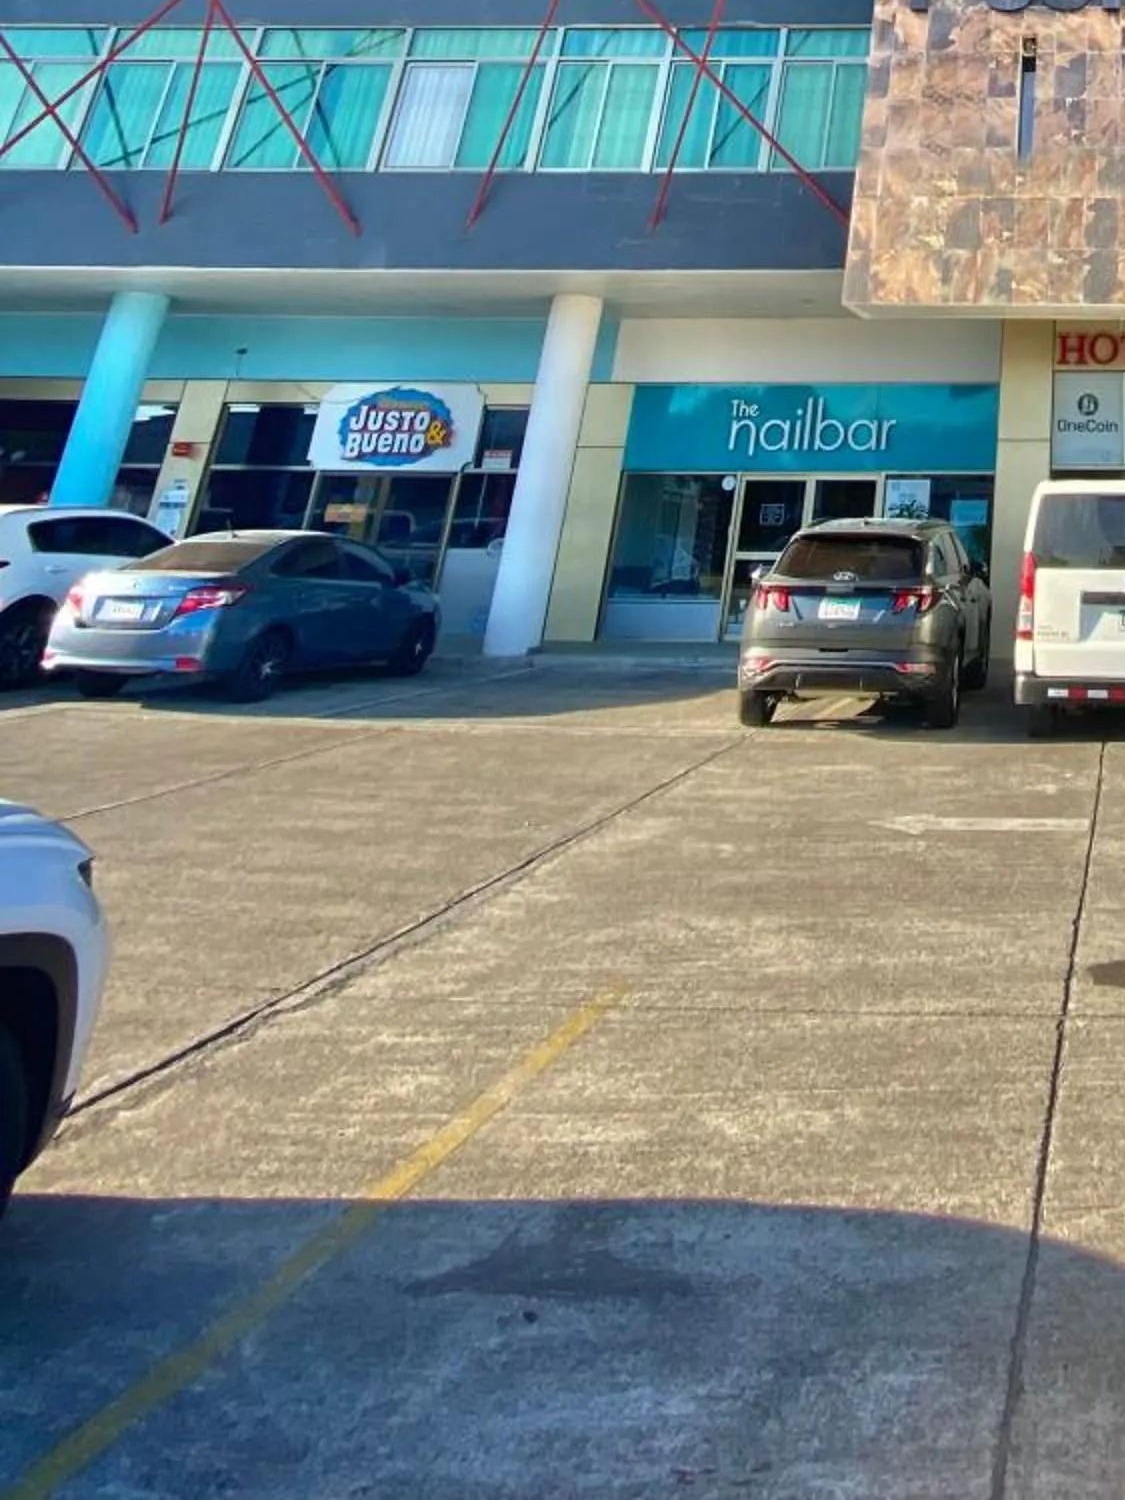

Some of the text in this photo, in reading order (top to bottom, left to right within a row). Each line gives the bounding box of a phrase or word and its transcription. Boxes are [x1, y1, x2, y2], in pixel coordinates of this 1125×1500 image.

[731, 398, 760, 417] The
[427, 419, 447, 446] &
[728, 396, 897, 457] nailbar
[1057, 418, 1119, 434] OneCoin
